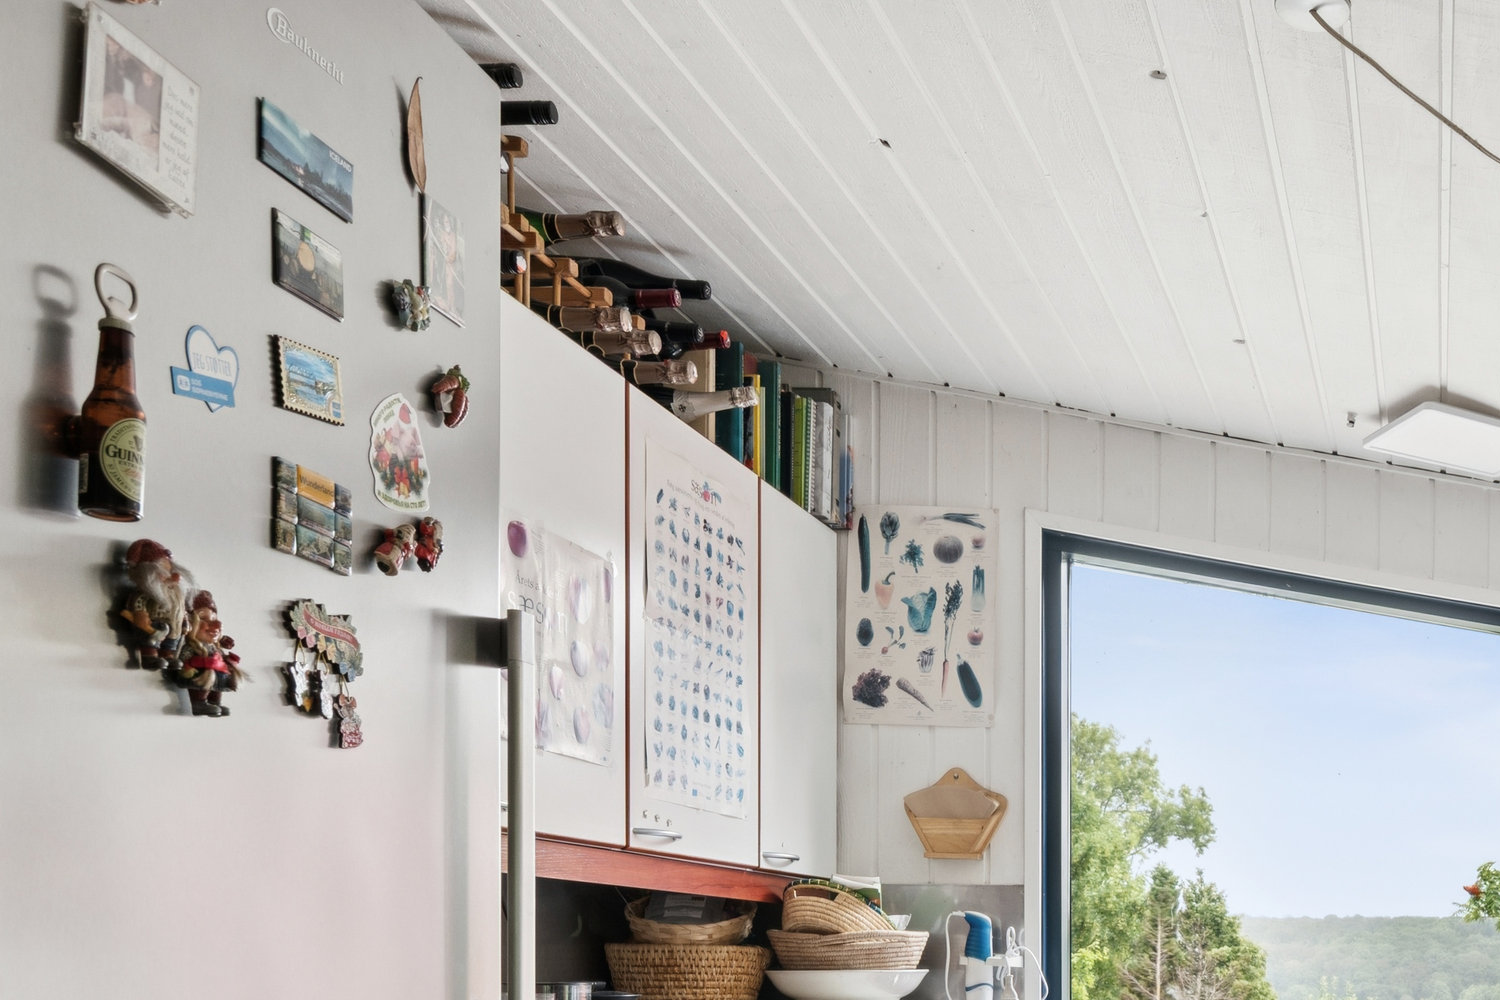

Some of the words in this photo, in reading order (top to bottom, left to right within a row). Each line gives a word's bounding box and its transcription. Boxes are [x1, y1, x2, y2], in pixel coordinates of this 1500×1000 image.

[276, 13, 344, 86] Bauknecht
[328, 148, 353, 174] ICELAND
[191, 352, 206, 371] JEG
